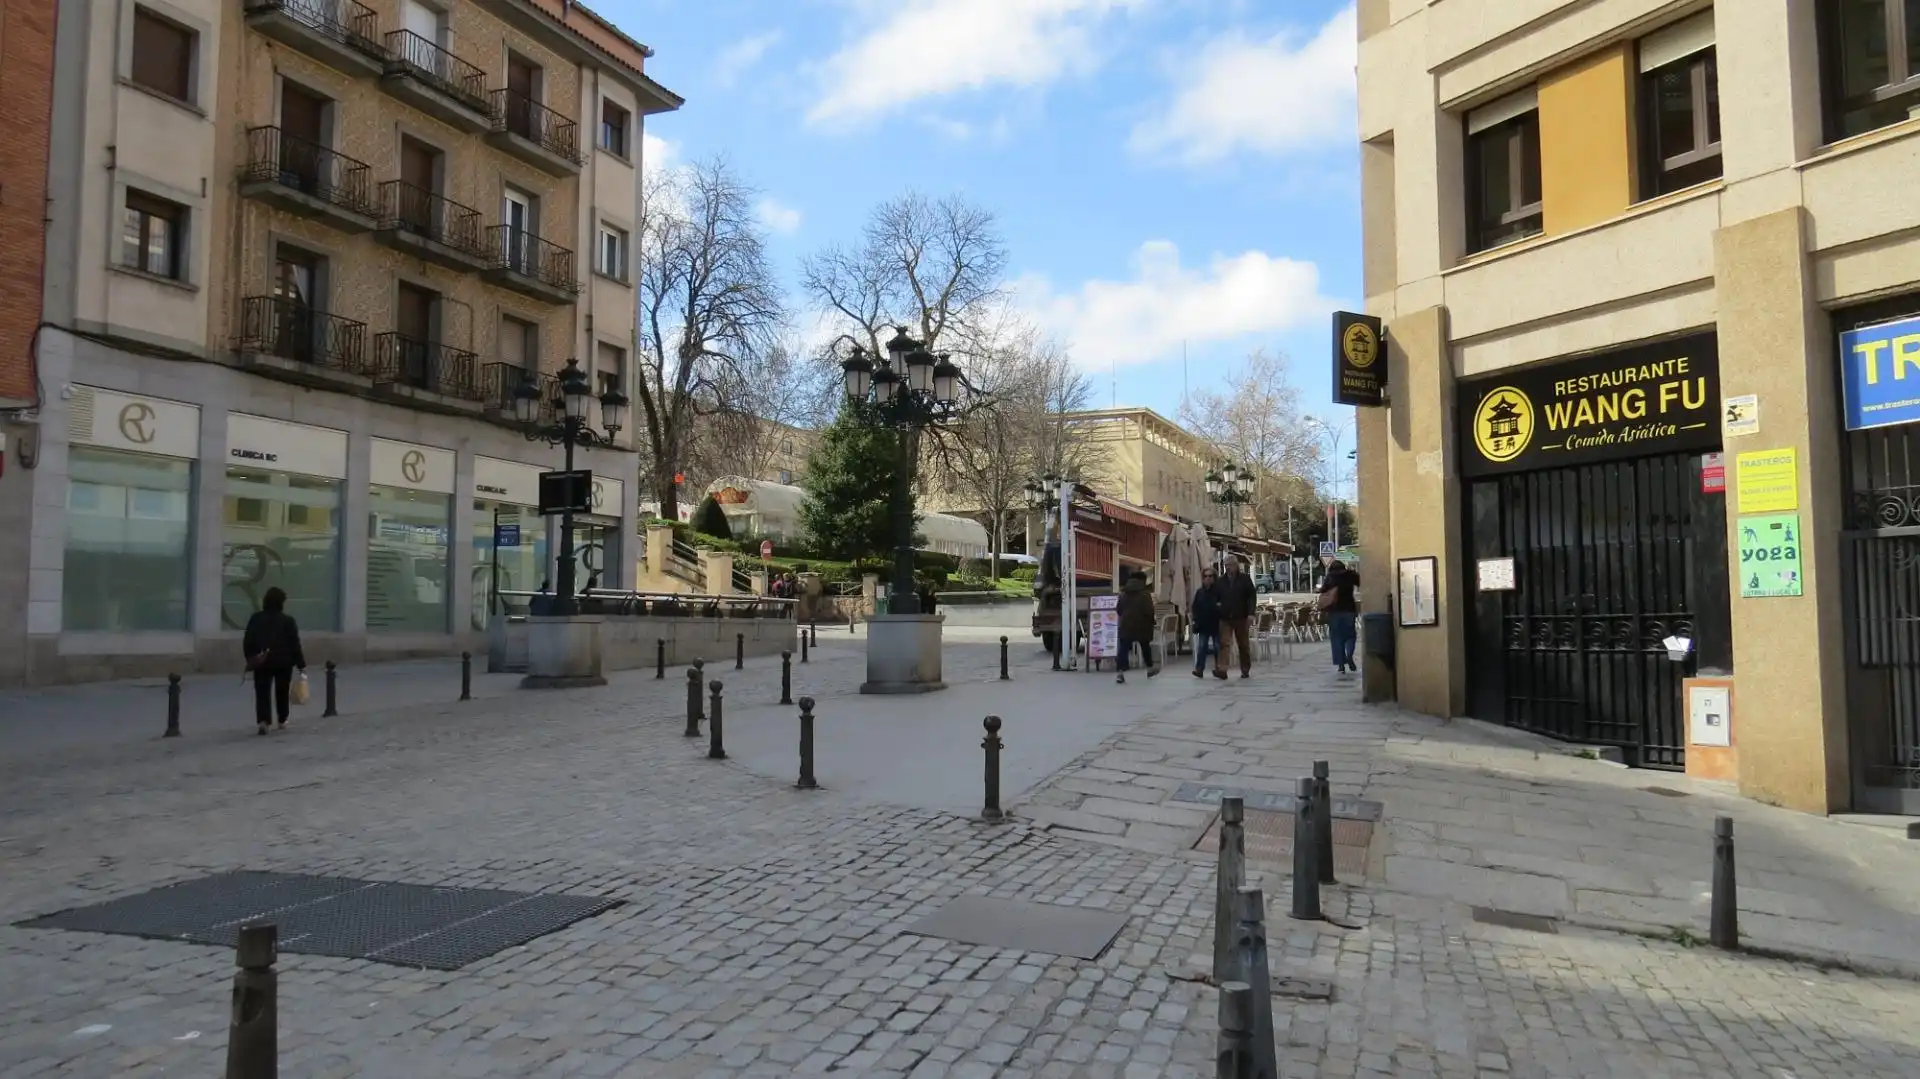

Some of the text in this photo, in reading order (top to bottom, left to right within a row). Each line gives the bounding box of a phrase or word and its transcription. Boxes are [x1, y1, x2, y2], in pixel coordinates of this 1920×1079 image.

[1344, 377, 1367, 388] WANG
[1555, 357, 1690, 396] RESTAURANTE
[1544, 377, 1706, 431] WANG FU
[1566, 423, 1676, 450] Comida Asiática
[1740, 456, 1793, 469] TRASTEROS
[1742, 545, 1796, 562] yoga
